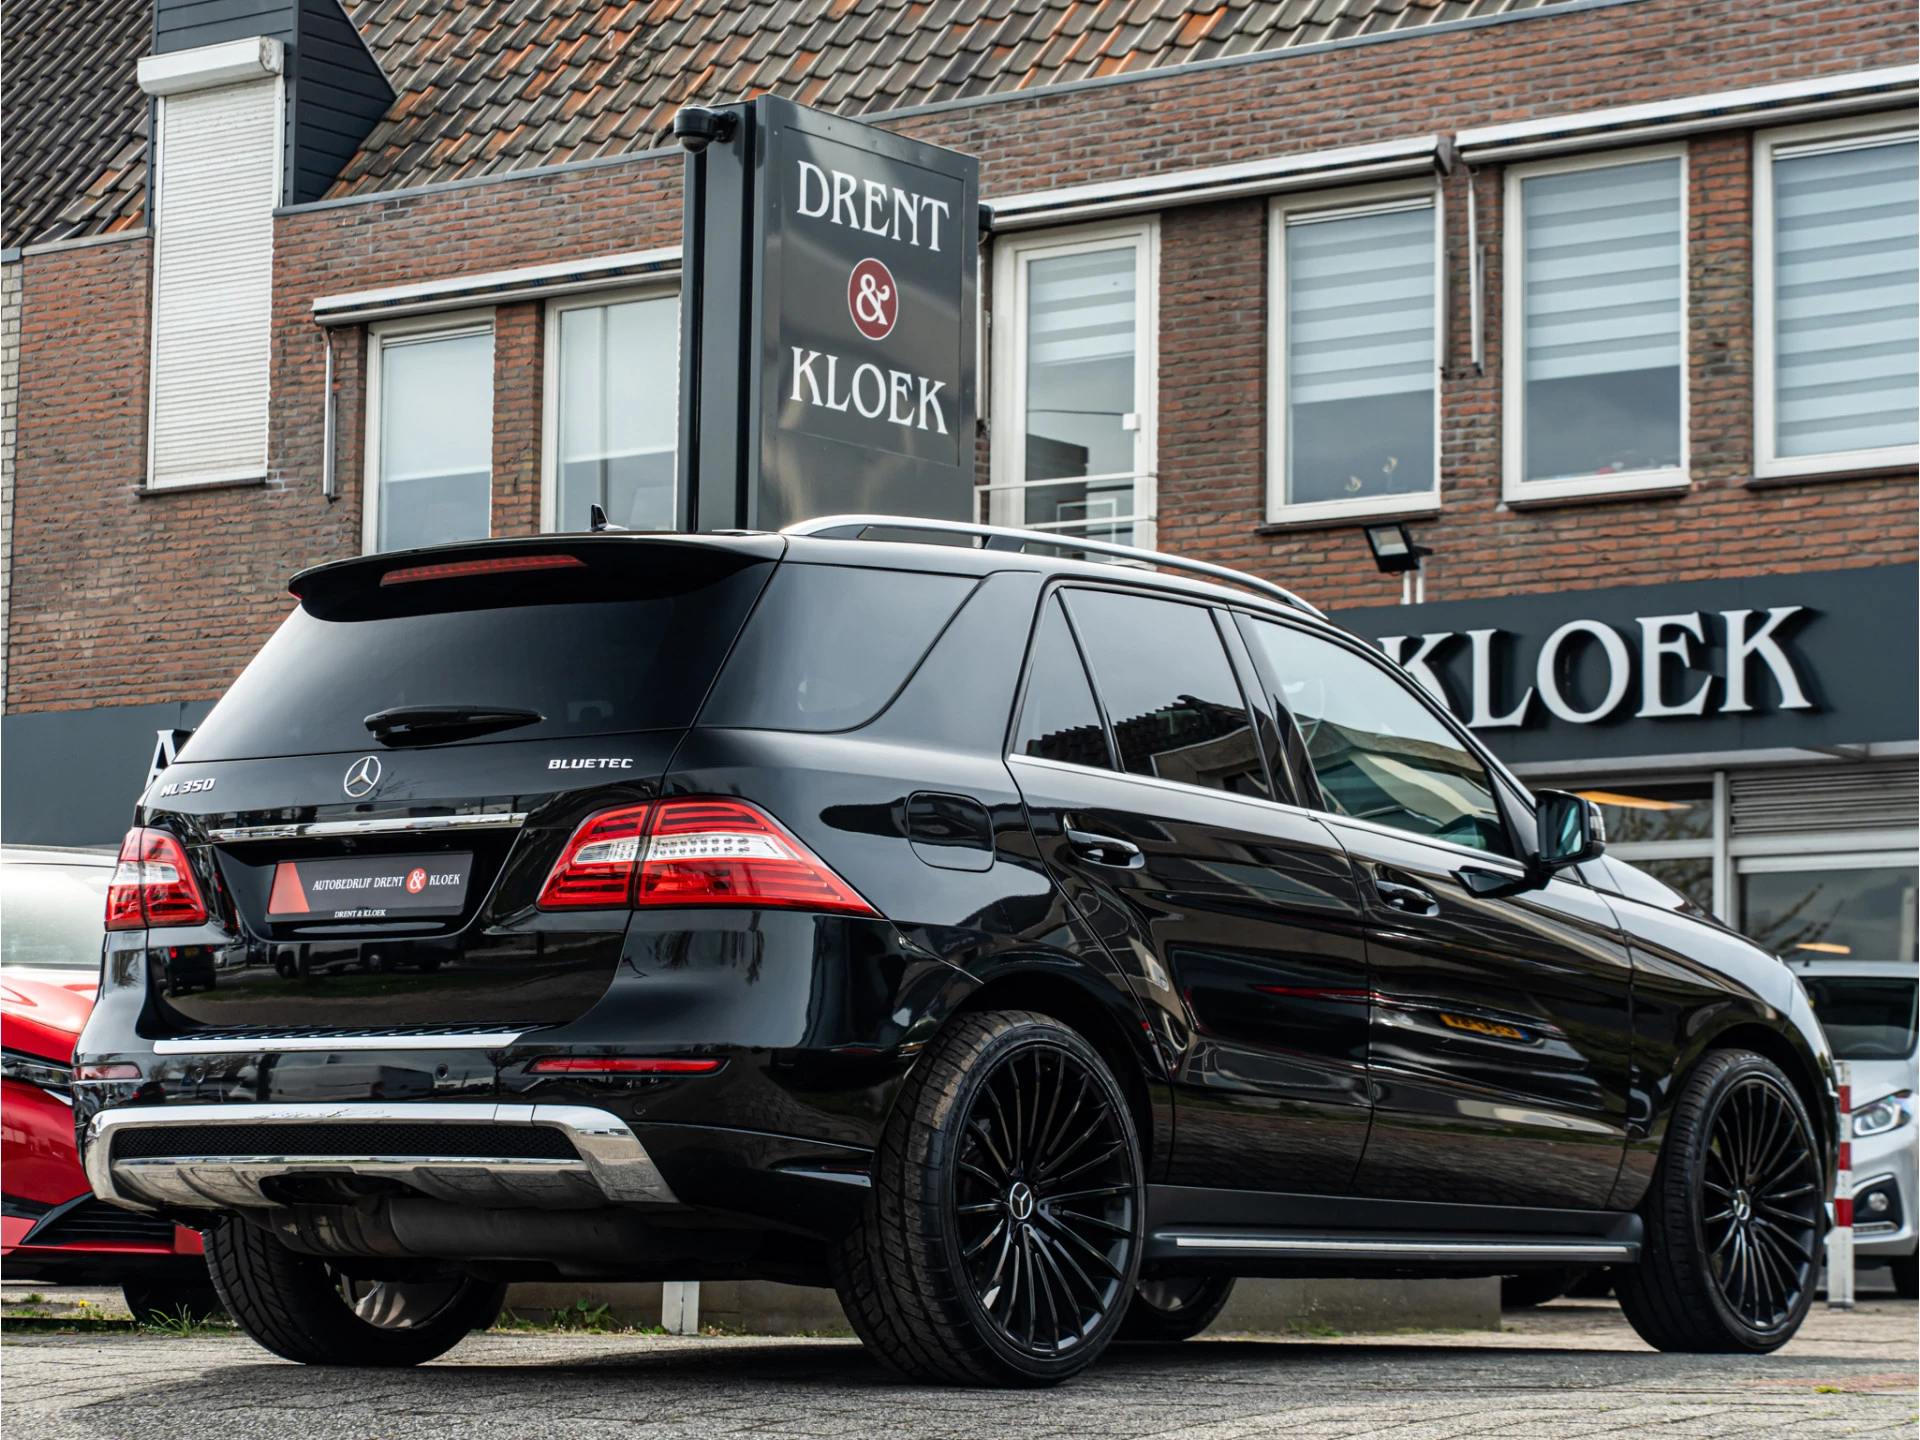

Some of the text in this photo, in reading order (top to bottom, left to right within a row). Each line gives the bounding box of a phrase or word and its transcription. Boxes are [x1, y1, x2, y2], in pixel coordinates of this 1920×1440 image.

[797, 160, 950, 252] DRENT
[856, 273, 891, 325] &
[790, 346, 949, 435] KLOEK
[1377, 606, 1812, 728] KLOEK
[548, 758, 634, 770] BLUETEC
[160, 778, 216, 797] ML 350
[312, 870, 461, 891] AUTOBEDRIJF DRENT & KLOEK
[334, 909, 387, 918] DRENT & KLOEK
